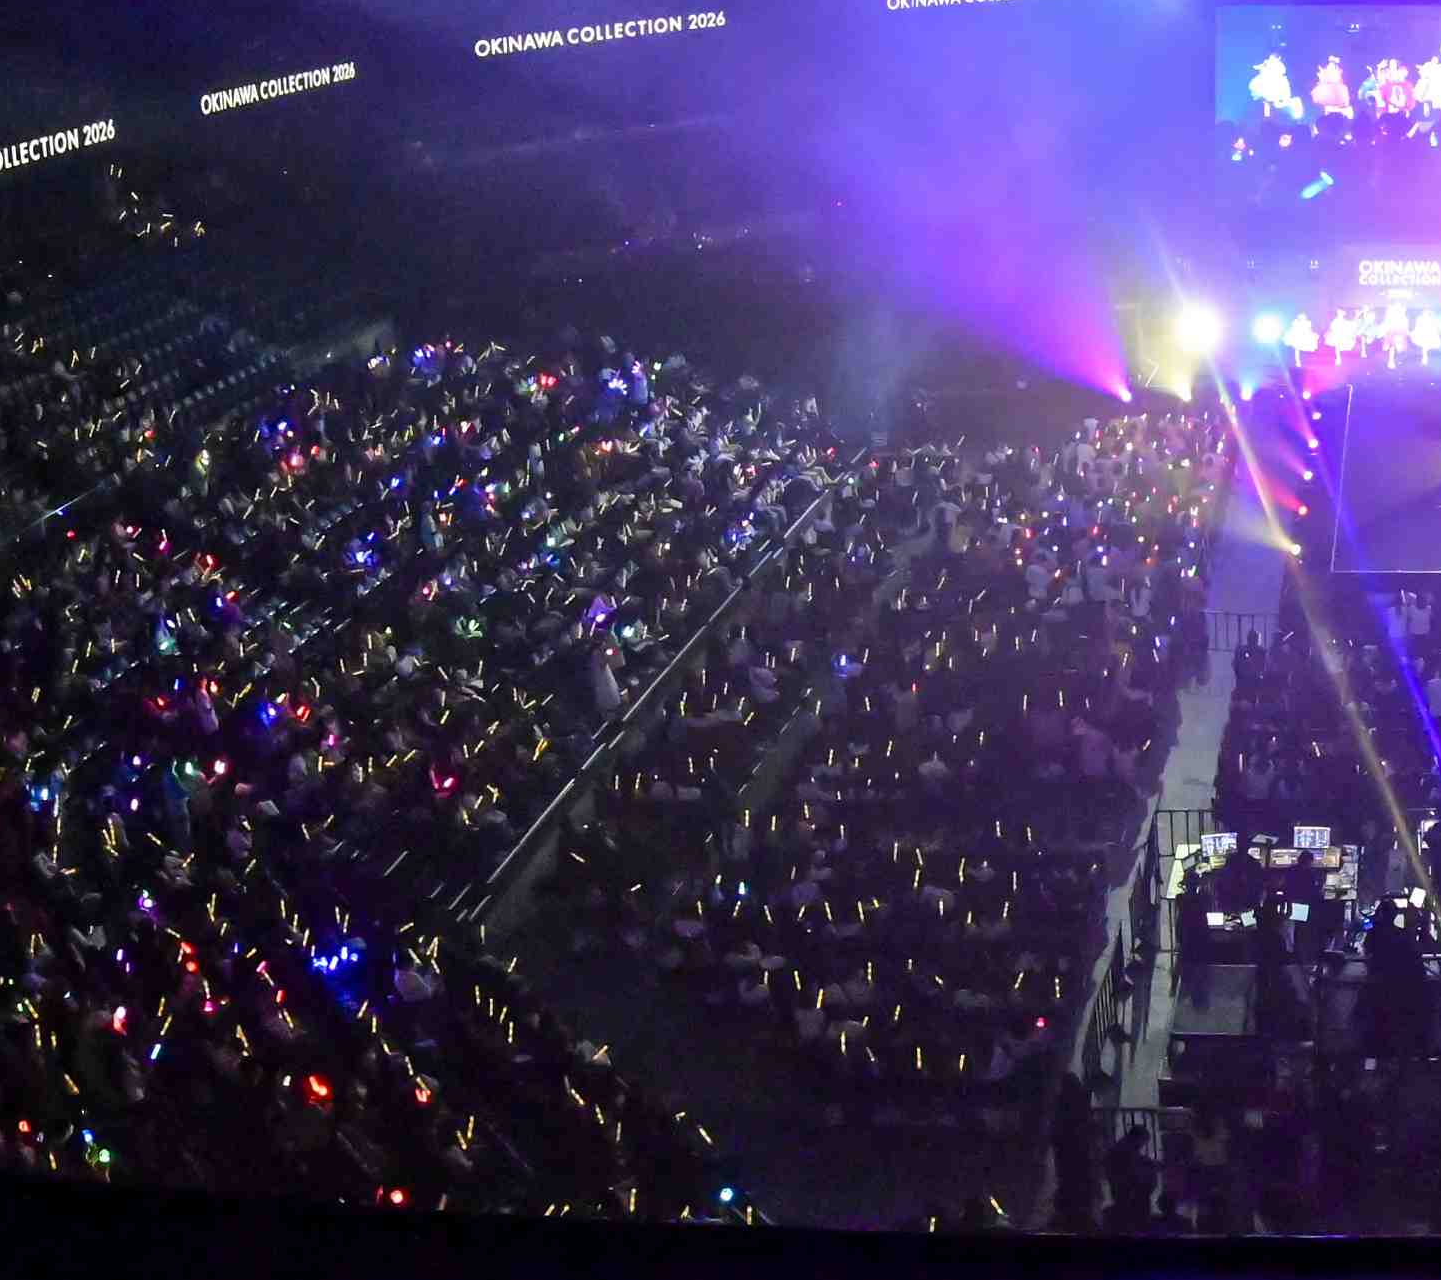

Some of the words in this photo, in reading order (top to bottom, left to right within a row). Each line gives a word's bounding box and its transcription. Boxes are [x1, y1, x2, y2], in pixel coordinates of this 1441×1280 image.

[474, 30, 564, 57] OKINAWA
[567, 16, 682, 44] COLLECTION
[688, 11, 726, 30] 2026
[200, 83, 260, 115] OKINAWA
[259, 66, 331, 100] COLLECTION
[331, 61, 356, 83] 2026
[82, 118, 116, 146] 2026
[1358, 260, 1440, 273] OKINAWA
